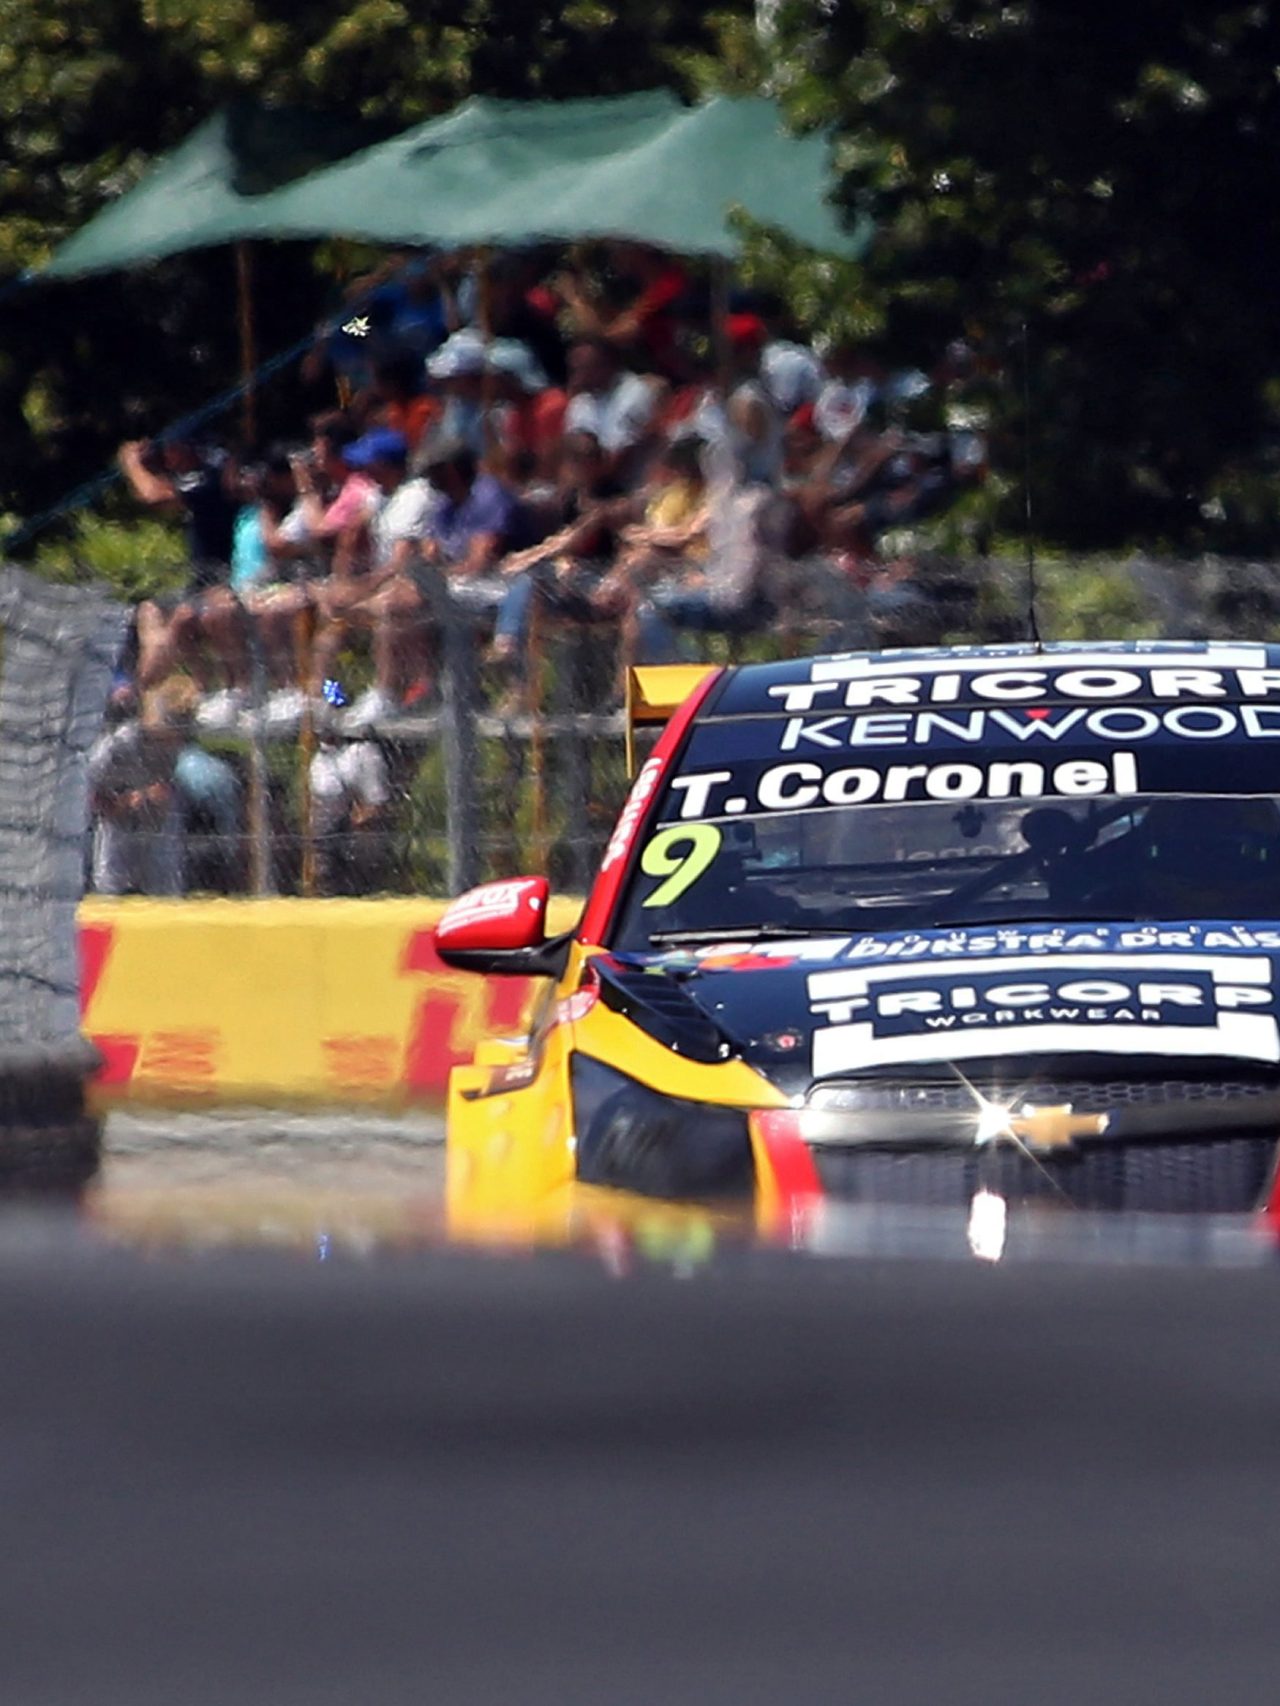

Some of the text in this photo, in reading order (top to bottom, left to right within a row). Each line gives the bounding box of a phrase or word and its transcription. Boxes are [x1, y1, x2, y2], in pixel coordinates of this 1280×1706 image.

[641, 823, 723, 908] 9
[810, 981, 1273, 1022] TRICORP
[926, 1007, 1162, 1029] WORKWEAR
